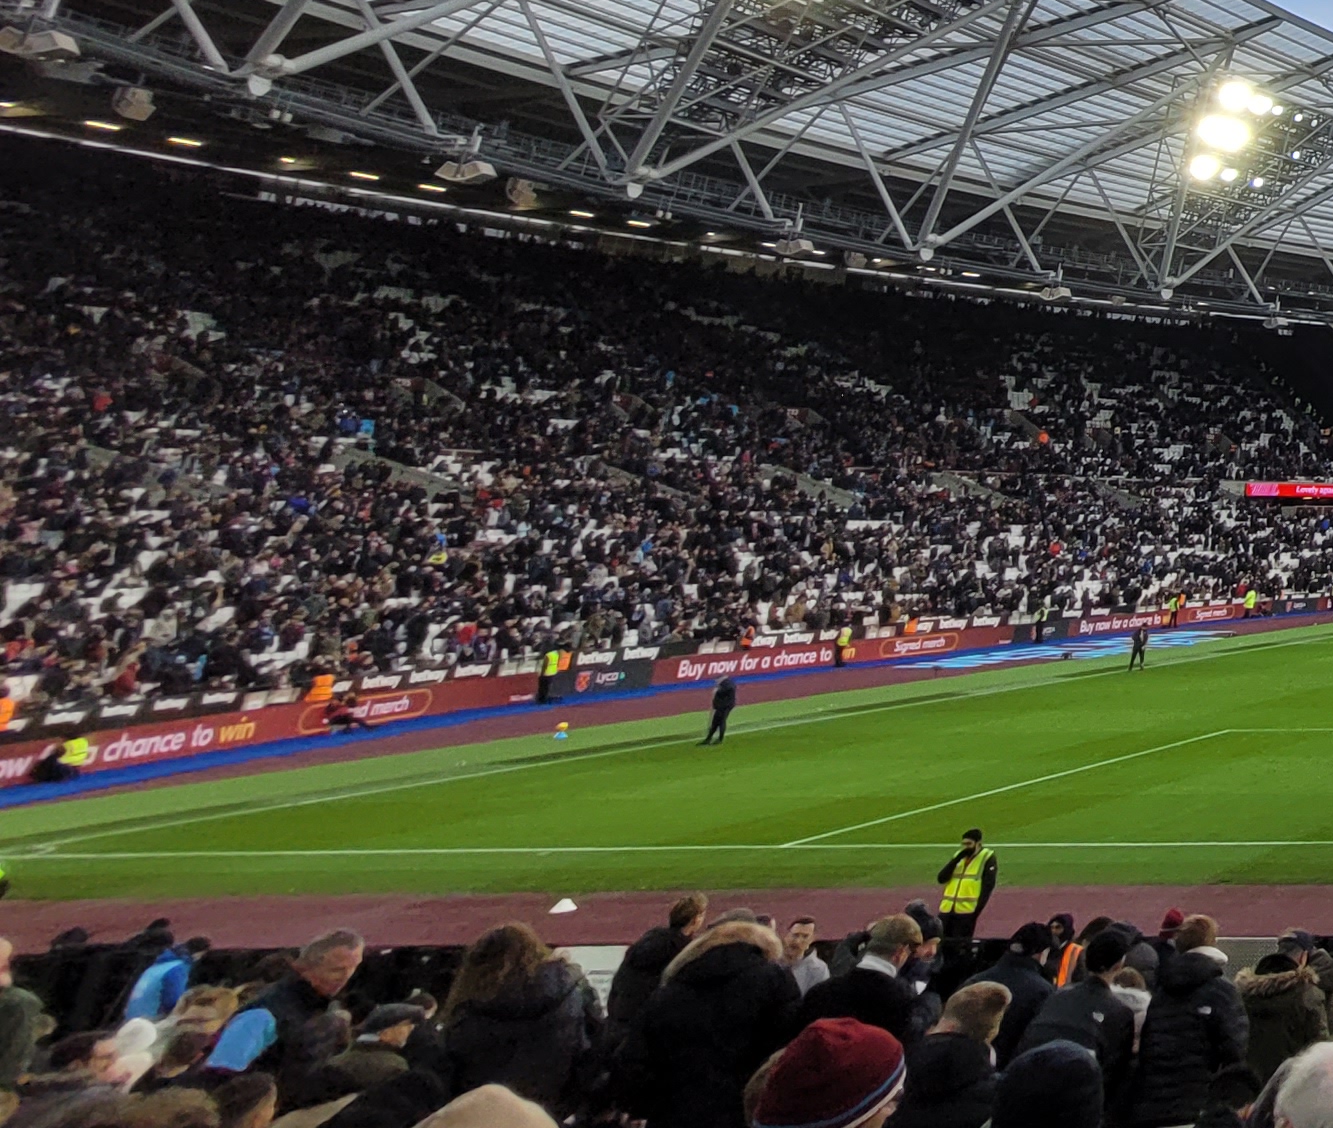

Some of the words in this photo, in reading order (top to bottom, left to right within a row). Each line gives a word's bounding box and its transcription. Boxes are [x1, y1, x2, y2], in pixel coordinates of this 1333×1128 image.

[1296, 485, 1318, 496] Lovely
[1079, 620, 1095, 636] Buy
[1095, 620, 1112, 632] now
[1112, 617, 1122, 630] for
[1122, 618, 1129, 628] a
[1154, 614, 1162, 626] to
[783, 630, 815, 645] betway
[893, 638, 923, 653] Signed
[922, 636, 946, 650] merch
[575, 650, 617, 667] betway
[622, 646, 661, 662] betway
[676, 659, 707, 680] Buy
[708, 659, 738, 675] now
[740, 654, 760, 672] for
[761, 655, 772, 669] a
[773, 649, 817, 668] chance
[819, 647, 833, 662] to
[369, 695, 410, 716] merch
[103, 732, 186, 763] chance
[190, 723, 214, 747] to
[218, 716, 256, 744] win
